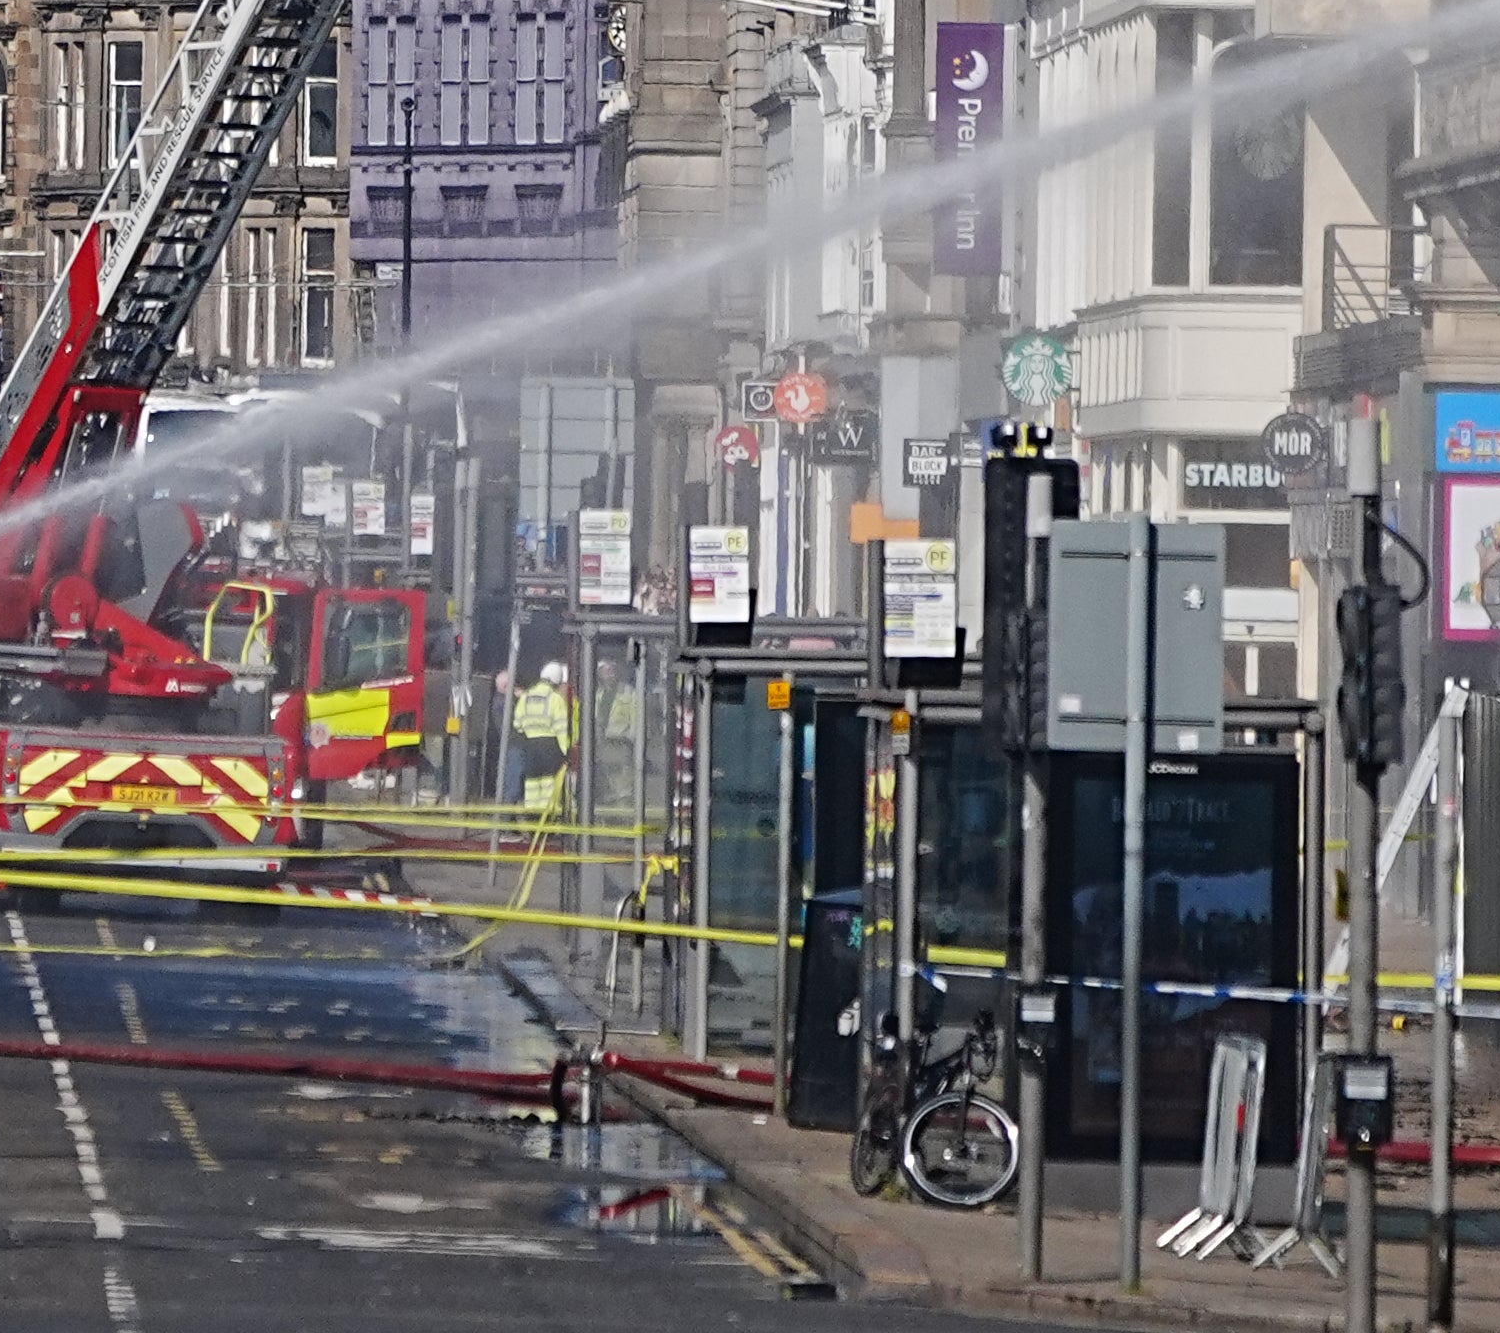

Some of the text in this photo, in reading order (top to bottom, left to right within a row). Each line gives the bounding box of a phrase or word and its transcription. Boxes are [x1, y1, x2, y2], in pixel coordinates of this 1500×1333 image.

[99, 45, 225, 285] SCOTTISH FIRE AND RESCUE SERVICE
[911, 460, 943, 472] BLOCK
[727, 537, 742, 549] PE
[930, 551, 948, 565] PF
